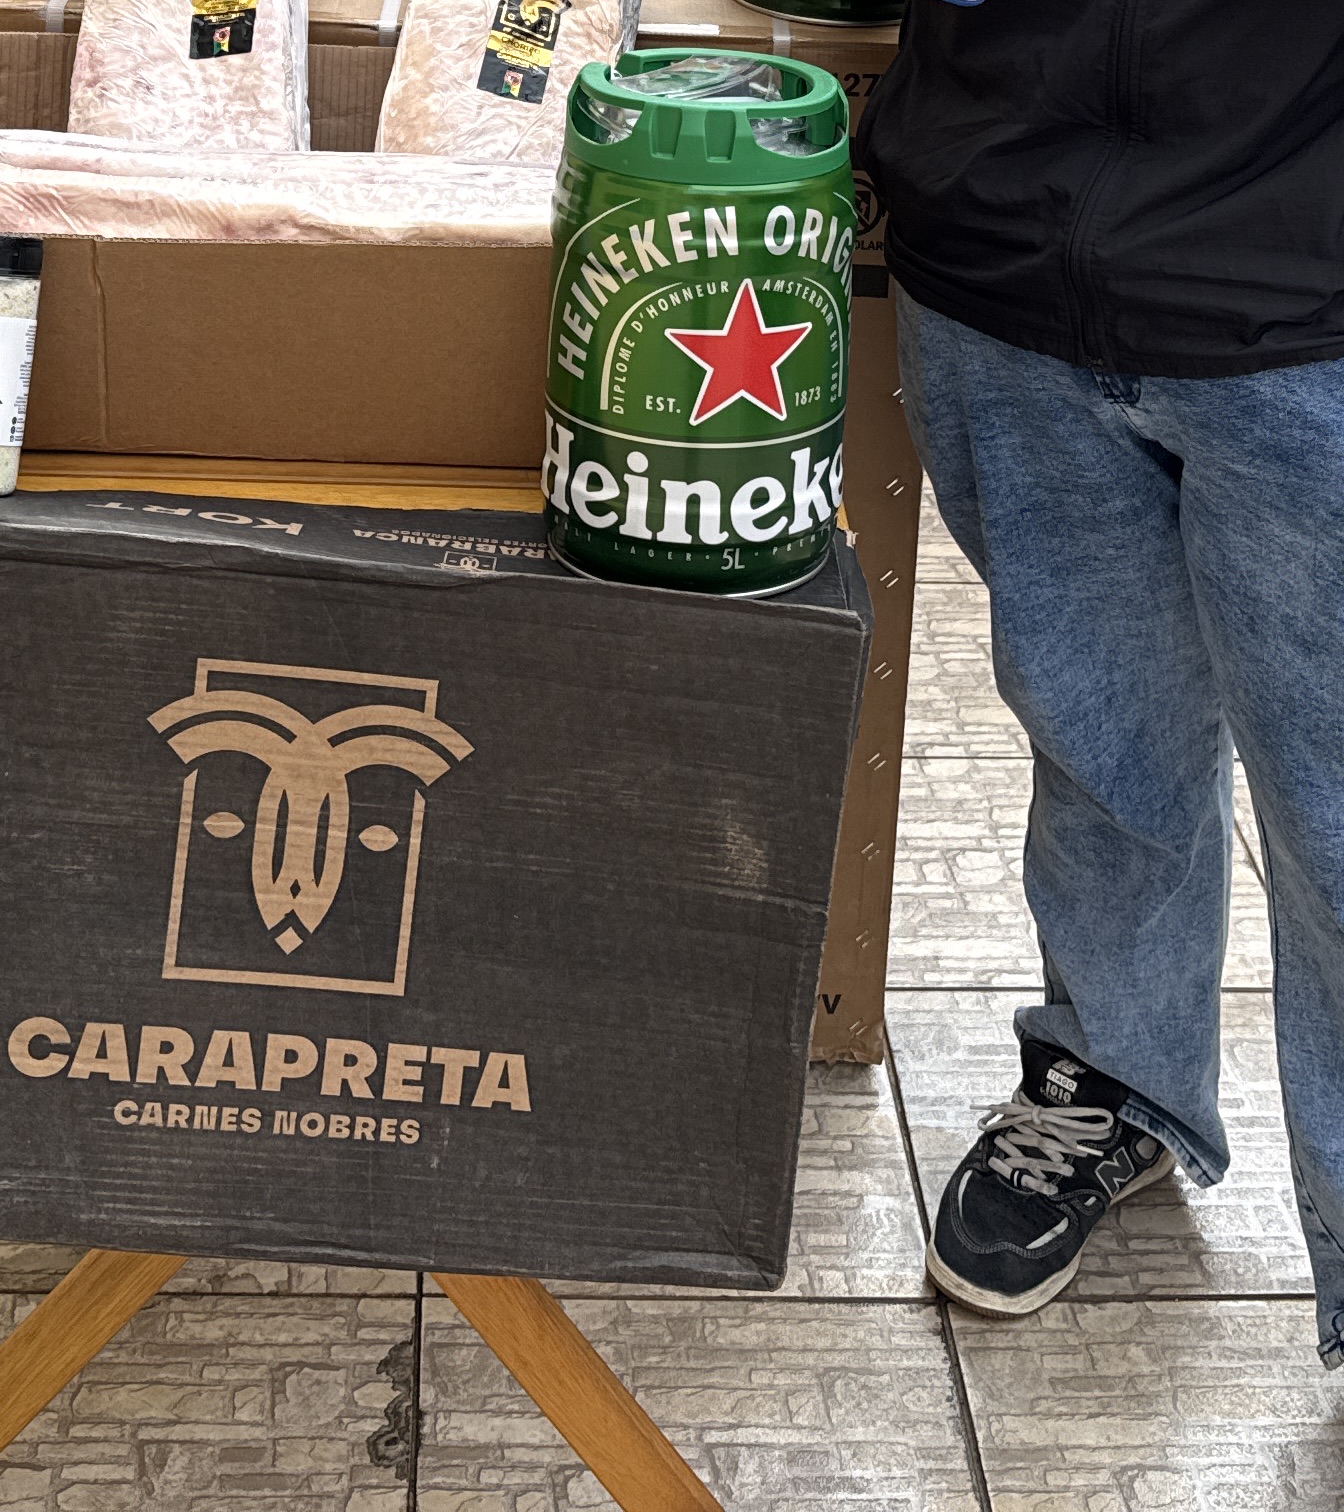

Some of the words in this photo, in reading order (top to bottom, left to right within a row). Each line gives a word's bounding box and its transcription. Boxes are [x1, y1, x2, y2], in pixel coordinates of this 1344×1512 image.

[558, 206, 739, 380] HEINEKEN
[762, 279, 834, 326] AMSTERDAM
[612, 337, 635, 414] DIPLOME
[631, 281, 730, 333] D'HONNEUR
[645, 394, 681, 414] EST.
[795, 386, 821, 406] 1873
[85, 501, 304, 536] KORT
[352, 529, 554, 560] RABRANCA
[613, 541, 692, 562] LAGER
[720, 548, 745, 571] 5L
[8, 1016, 532, 1112] CARAPRETA
[113, 1099, 262, 1134] CARNES
[273, 1110, 421, 1145] NOBRES
